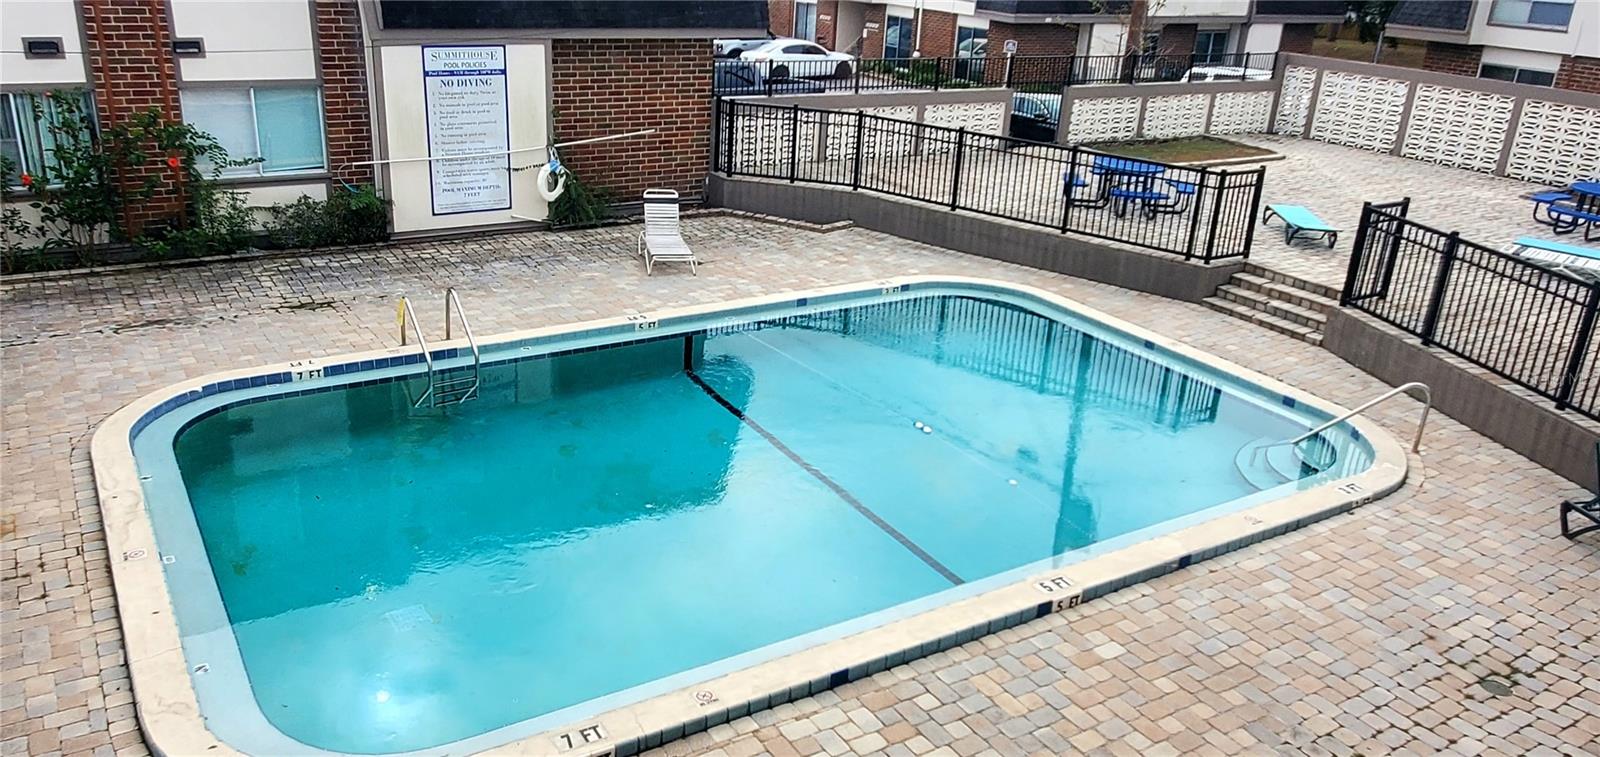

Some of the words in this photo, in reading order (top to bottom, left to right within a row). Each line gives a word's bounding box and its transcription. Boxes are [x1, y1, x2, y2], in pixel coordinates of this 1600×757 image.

[440, 80, 454, 88] NO
[457, 78, 492, 87] DIVING
[297, 372, 303, 380] 7
[309, 369, 321, 378] FT
[1039, 582, 1054, 592] 5
[1051, 577, 1071, 589] FT
[1054, 601, 1063, 613] 5
[1069, 595, 1080, 608] FT
[560, 734, 573, 748] 7
[579, 725, 603, 742] FT
